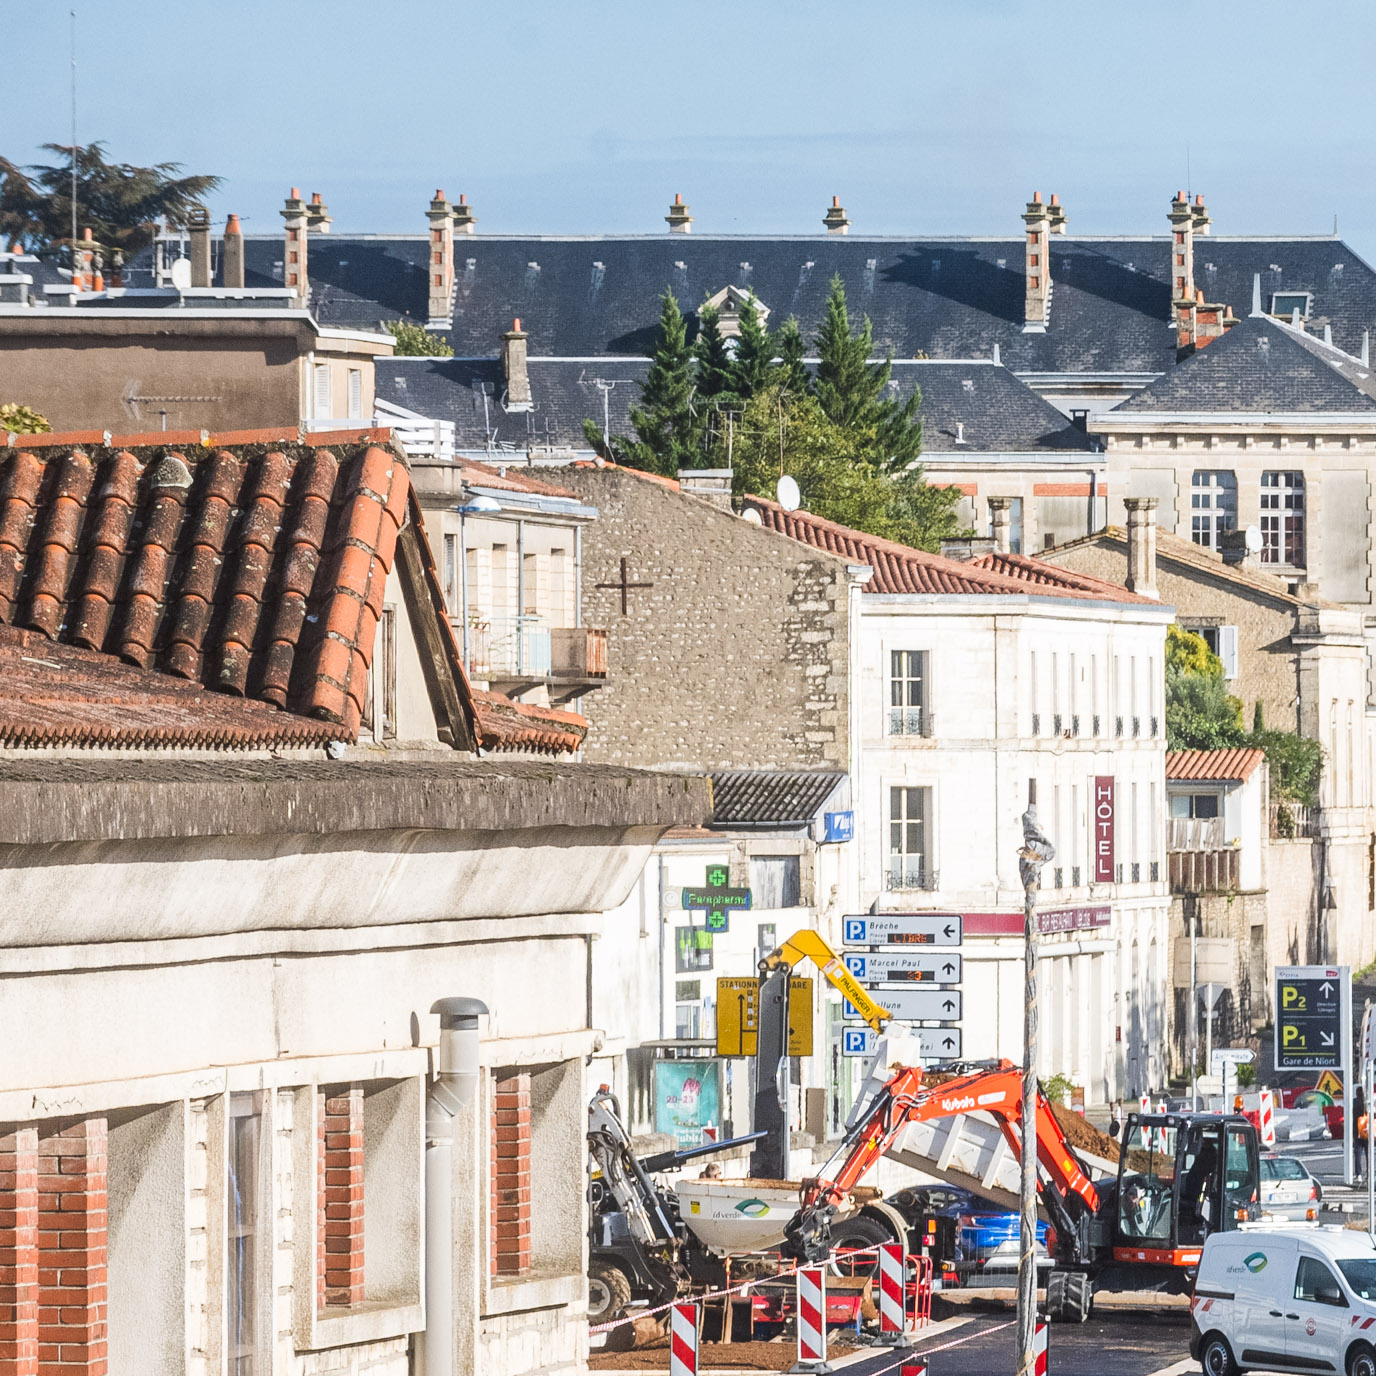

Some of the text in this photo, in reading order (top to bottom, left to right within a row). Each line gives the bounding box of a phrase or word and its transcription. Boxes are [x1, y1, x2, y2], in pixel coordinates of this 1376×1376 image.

[1096, 786, 1113, 874] HÔTEL
[869, 921, 899, 930] Brèche
[893, 933, 927, 943] LIBRE
[869, 959, 899, 967] Marcel
[901, 959, 921, 967] Paul
[719, 981, 808, 989] STATIONN ARE
[840, 977, 871, 1014] PALFINGER
[1282, 986, 1307, 1008] P2
[876, 1001, 902, 1009] ellune
[1282, 1025, 1306, 1047] P1
[1283, 1057, 1336, 1066] Gare de Niort
[942, 1095, 975, 1111] Kubota
